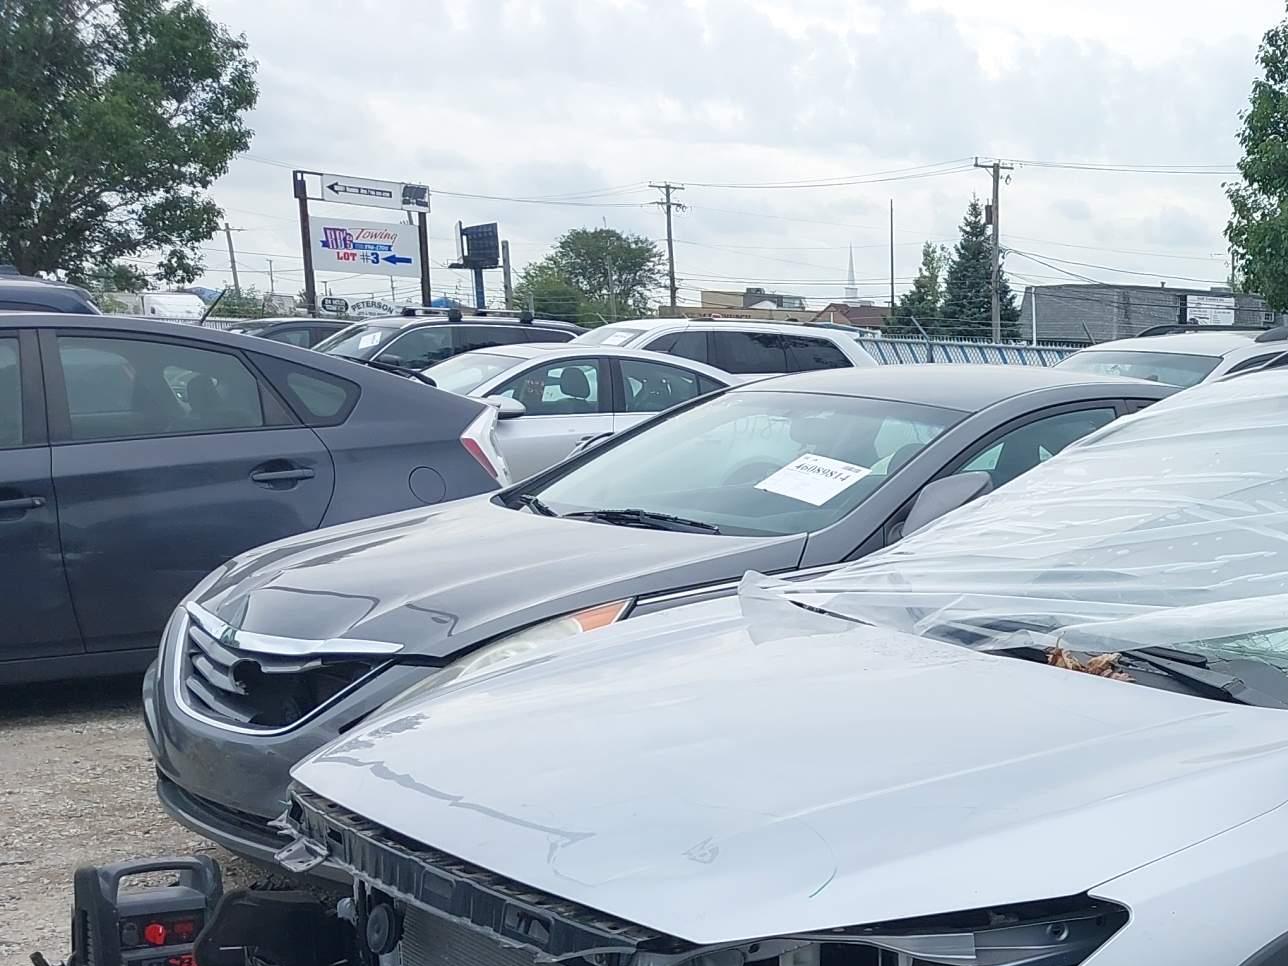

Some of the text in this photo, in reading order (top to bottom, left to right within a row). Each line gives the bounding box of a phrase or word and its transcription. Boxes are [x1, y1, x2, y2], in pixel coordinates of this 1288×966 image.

[354, 228, 397, 246] Towing
[336, 251, 379, 264] LOT #3
[351, 301, 394, 314] PETERSON
[795, 463, 852, 482] 46089814
